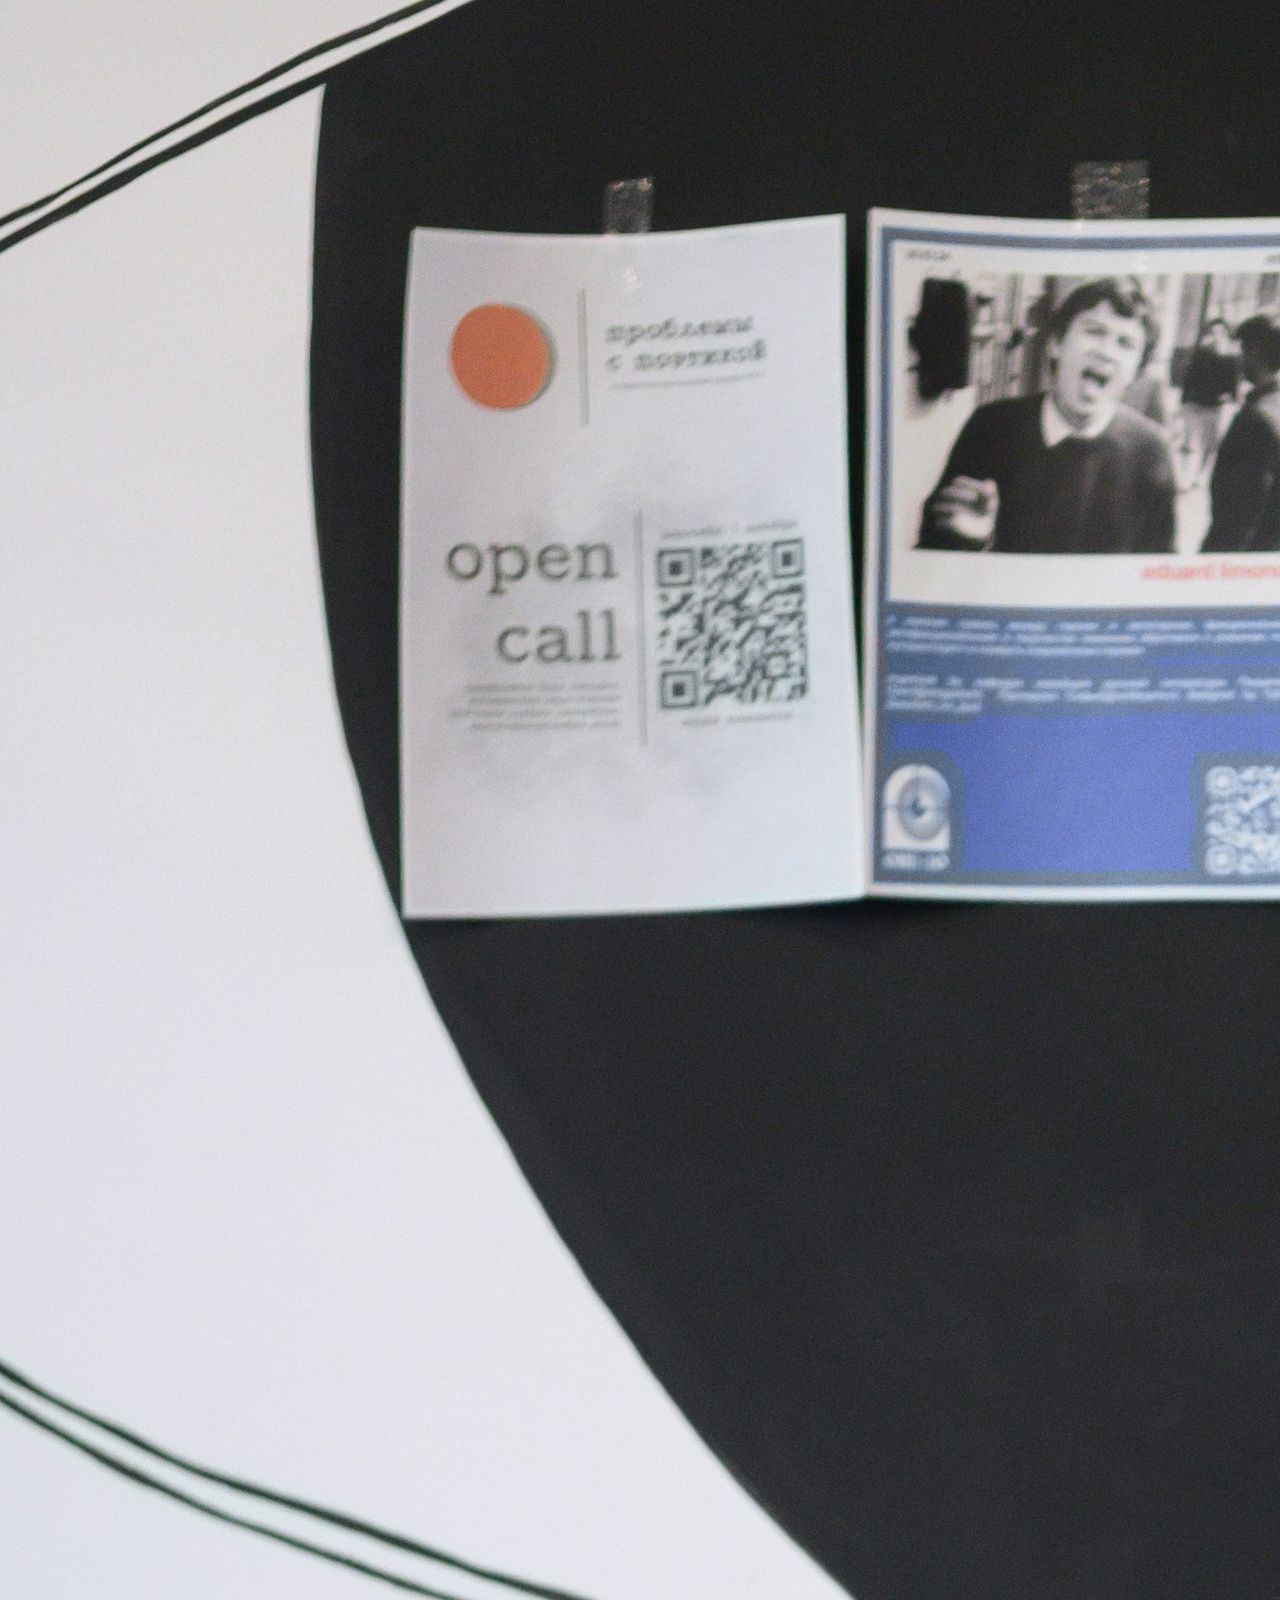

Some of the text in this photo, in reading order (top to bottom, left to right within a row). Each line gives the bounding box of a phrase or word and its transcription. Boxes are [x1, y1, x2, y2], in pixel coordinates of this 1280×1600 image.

[605, 316, 754, 346] проблемы
[446, 542, 620, 597] open
[496, 608, 622, 664] call
